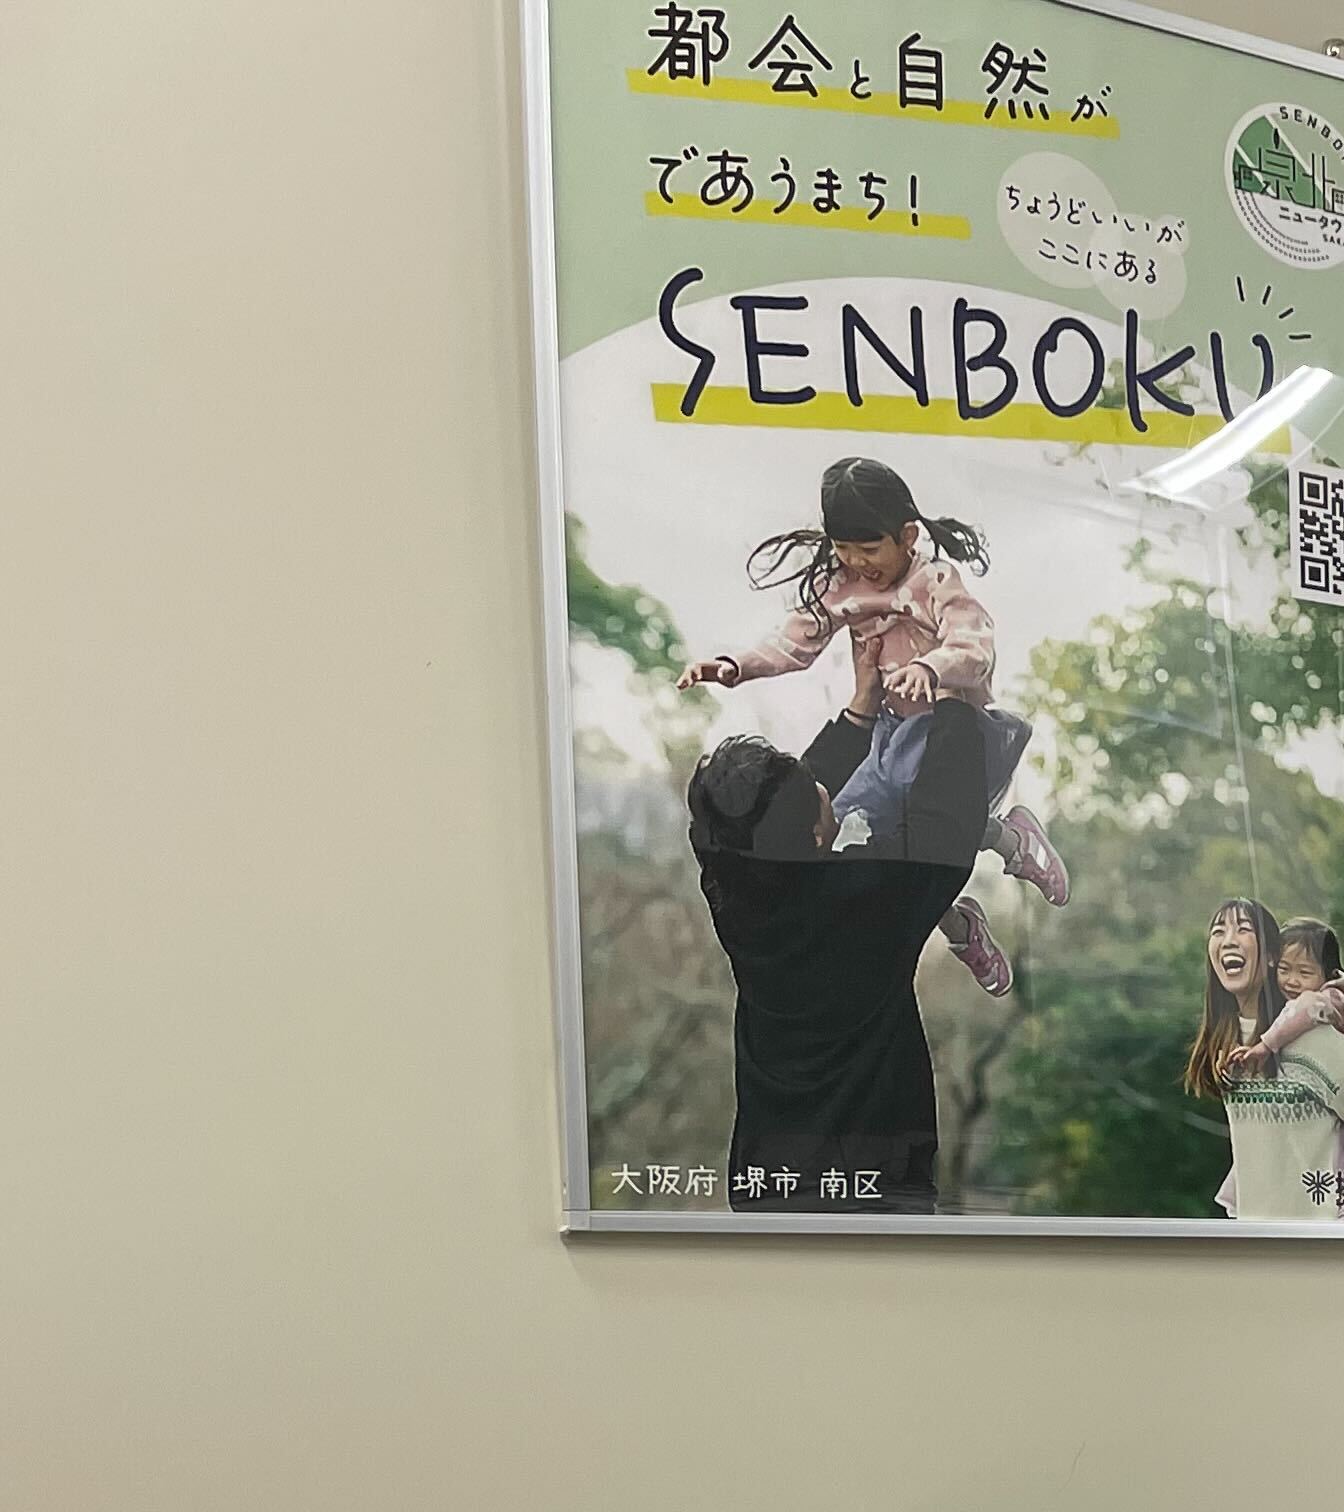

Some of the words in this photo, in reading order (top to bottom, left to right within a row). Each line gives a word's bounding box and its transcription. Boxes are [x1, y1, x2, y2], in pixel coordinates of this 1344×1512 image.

[647, 1, 1113, 122] 都会と自然が
[1006, 185, 1185, 244] ちょうどいいが
[1038, 238, 1157, 285] ここにある
[658, 267, 1274, 433] SENBOKU
[611, 1163, 719, 1197] 大阪府
[731, 1165, 801, 1199] 堺市
[819, 1168, 882, 1199] 南区
